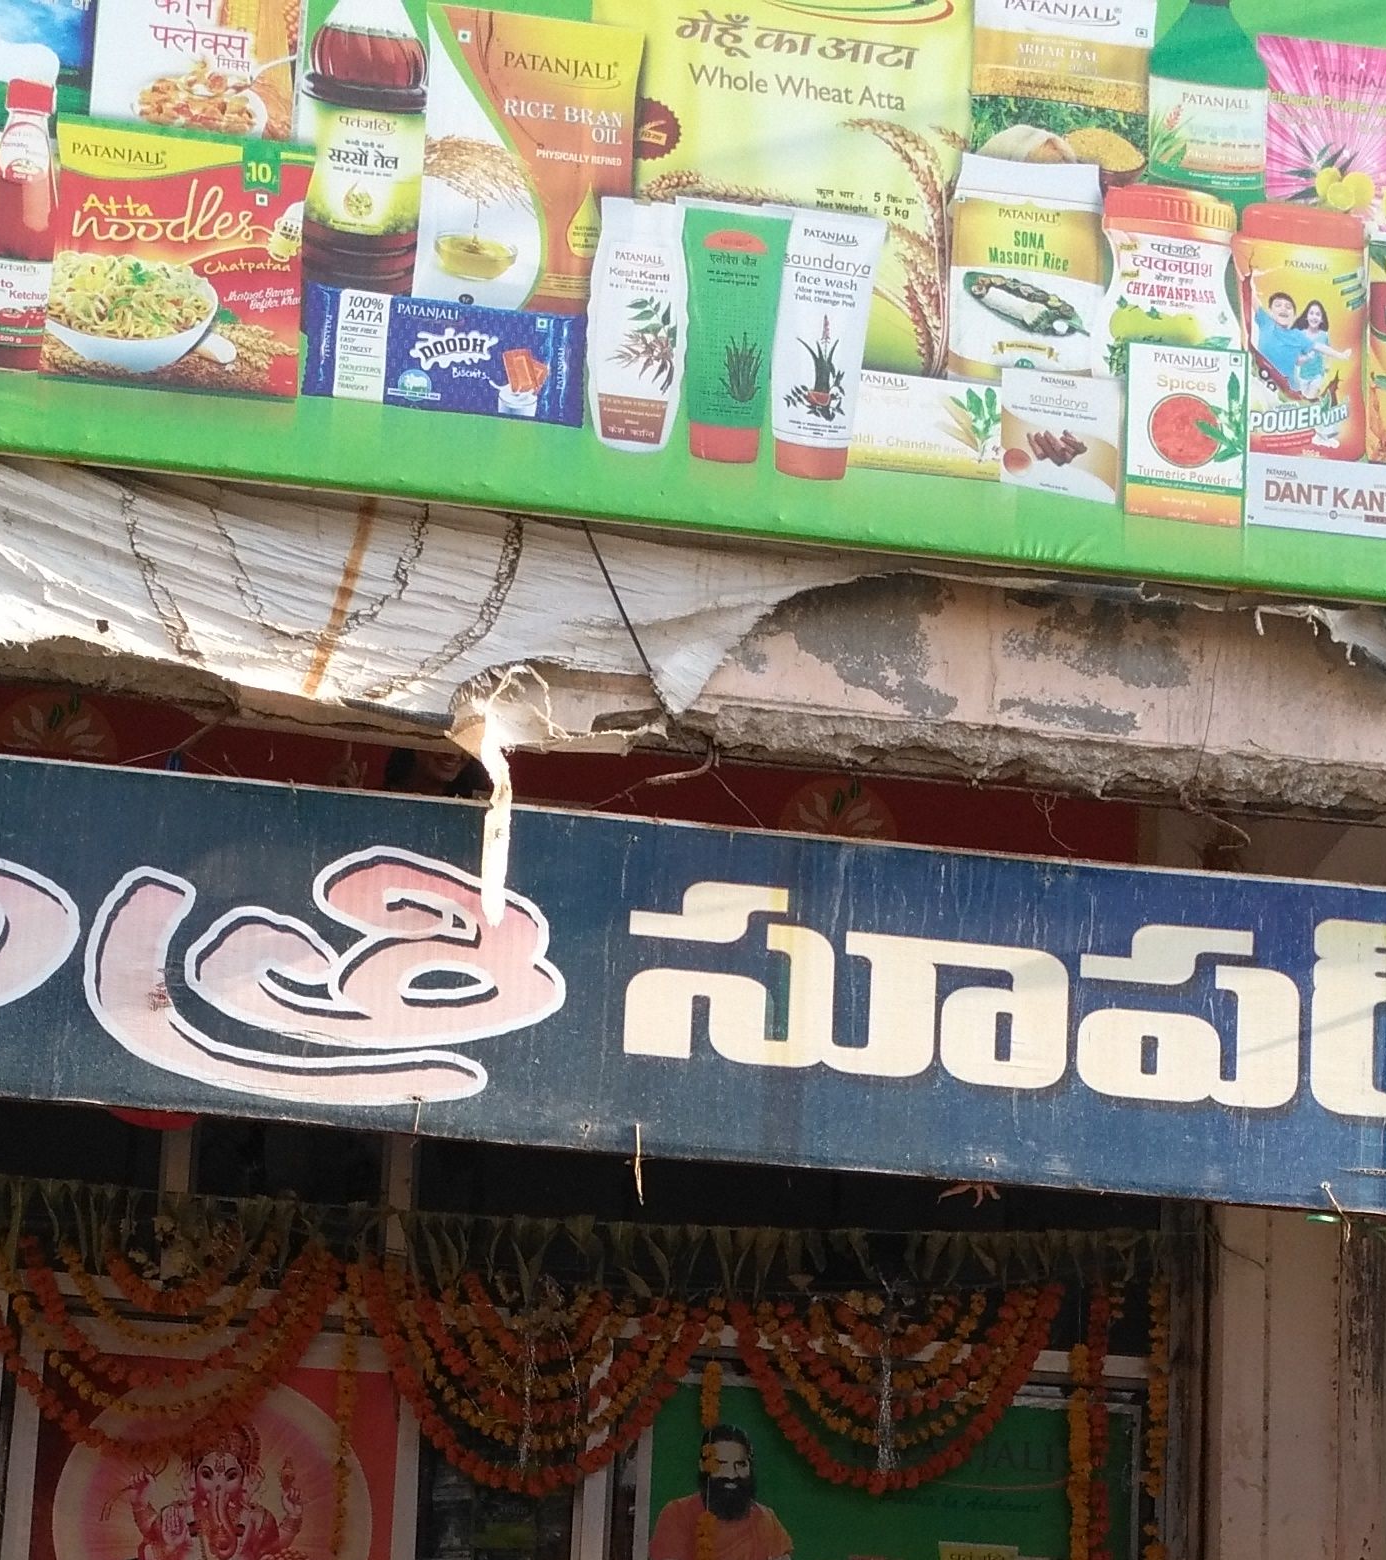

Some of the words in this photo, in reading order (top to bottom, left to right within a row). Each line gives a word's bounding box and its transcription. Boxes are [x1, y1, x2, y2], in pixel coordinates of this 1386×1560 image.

[149, 19, 249, 60] फ्लेक्स
[675, 13, 750, 59] गेहूँ
[755, 25, 816, 57] का
[817, 34, 919, 71] आटा
[504, 50, 614, 82] PATANJALI
[689, 62, 769, 95] Whole
[775, 75, 854, 106] Wheat
[858, 86, 905, 112] Atta
[1182, 91, 1251, 111] PATANJALI
[1323, 95, 1370, 115] Powder
[504, 97, 556, 121] RICE
[565, 106, 623, 128] BRAN
[591, 127, 623, 145] OIL
[72, 141, 163, 165] PATANJALI
[327, 147, 369, 168] सरसों
[373, 150, 400, 171] तेल
[536, 148, 589, 165] PHYSICALLY
[591, 154, 623, 167] REFINED
[72, 178, 255, 244] noodles
[82, 193, 154, 218] Atta
[816, 200, 834, 211] Net
[835, 202, 869, 214] Weight
[882, 204, 892, 216] 5
[894, 206, 910, 221] kg
[998, 207, 1058, 224] PATANJALI
[803, 228, 857, 246] PATANJALI
[1013, 230, 1045, 250] SONA
[203, 257, 291, 276] Chatpataa
[615, 250, 663, 266] PATANJALI
[784, 251, 872, 277] saundarya
[988, 246, 1039, 268] Masoori
[1043, 252, 1070, 272] Rice
[1283, 258, 1328, 273] PATANJALI
[794, 271, 821, 286] face
[824, 276, 859, 292] wash
[9, 284, 48, 302] Ketchup
[348, 295, 384, 310] 100%
[1126, 280, 1217, 305] CHYAWANPRASH
[345, 309, 383, 324] AATA
[397, 303, 461, 321] PATANJALI
[340, 325, 360, 334] MORE
[418, 337, 487, 361] DOODH
[1153, 352, 1218, 370] PATANJALI
[1156, 373, 1218, 394] Spices
[1029, 393, 1090, 411] saundarya
[1250, 403, 1322, 434] POWER
[886, 435, 942, 452] Chandan
[1136, 464, 1187, 482] Turmeric
[1189, 471, 1233, 486] Powder
[1266, 467, 1298, 479] PATANJALI
[1265, 480, 1328, 504] DANT
